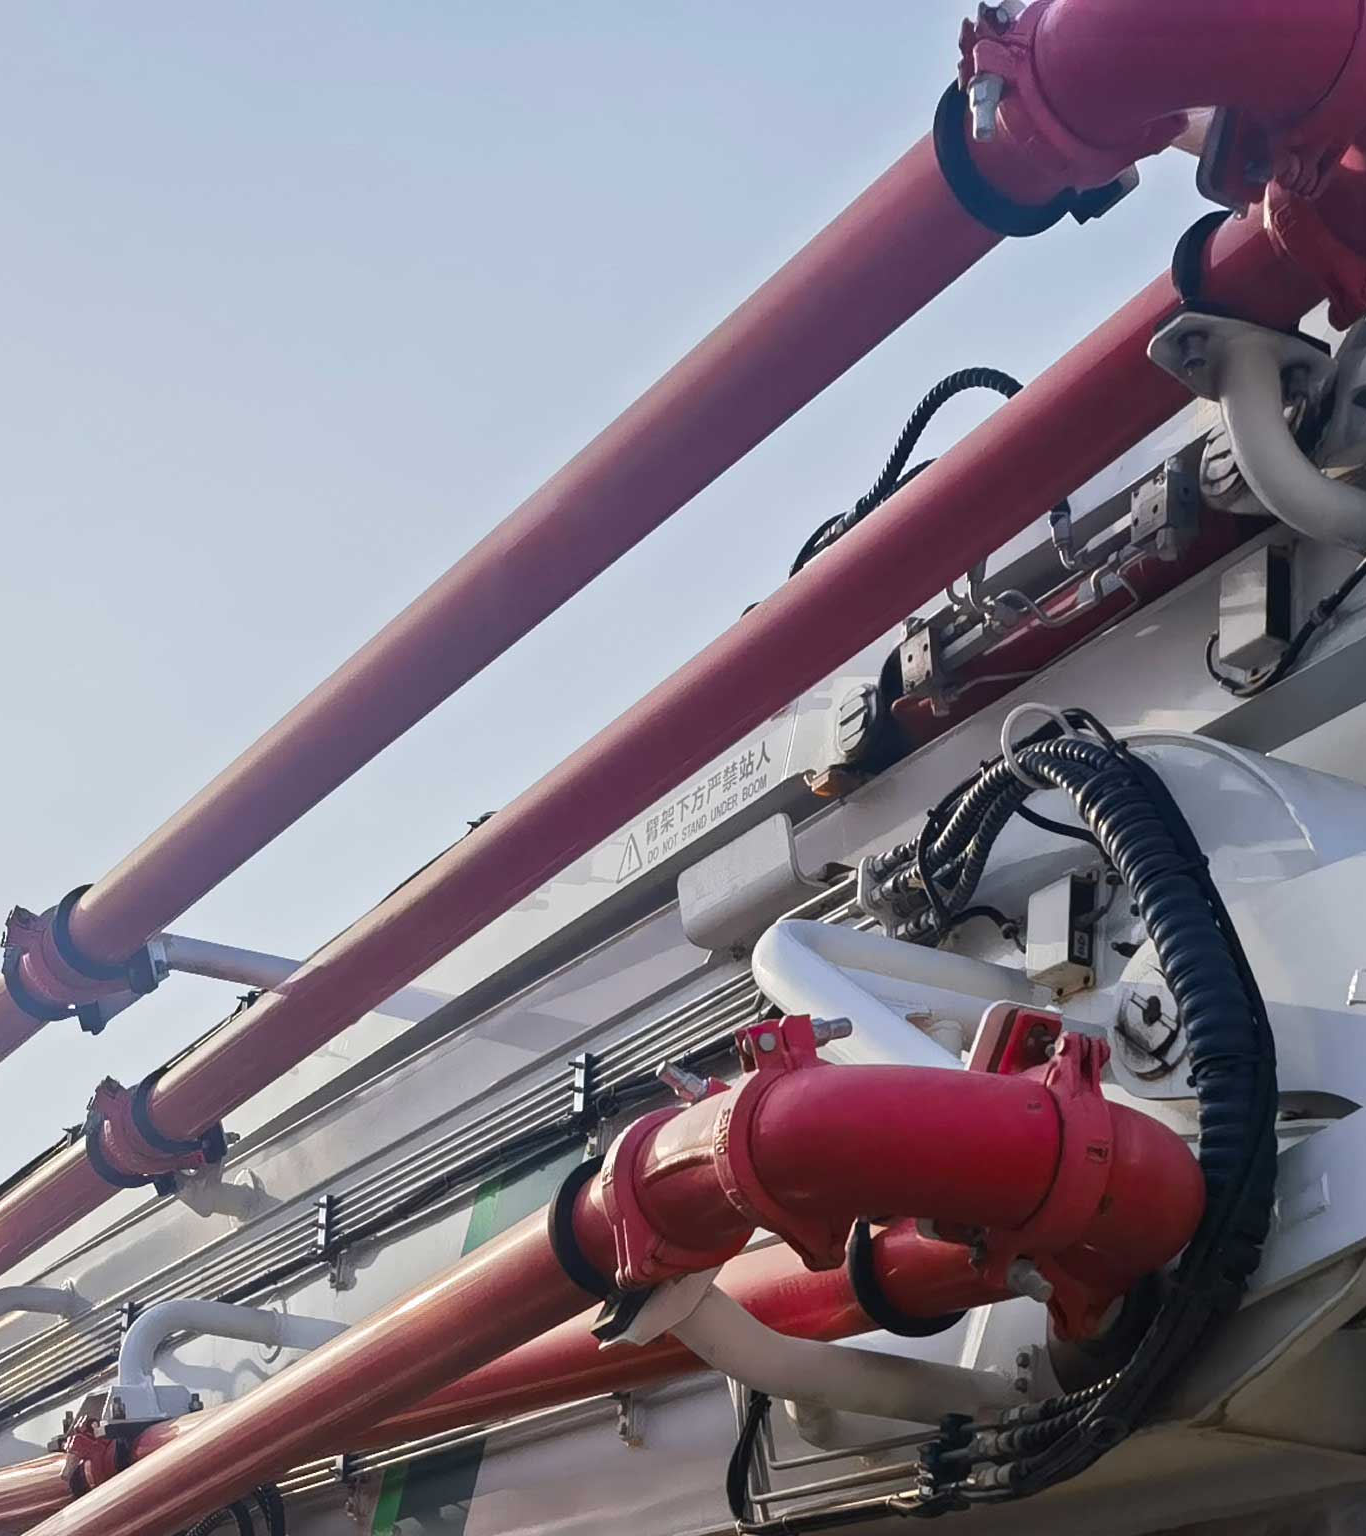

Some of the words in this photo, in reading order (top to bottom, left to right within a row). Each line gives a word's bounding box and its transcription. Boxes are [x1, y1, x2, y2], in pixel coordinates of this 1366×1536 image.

[646, 740, 771, 845] 臂架下方严禁站人
[647, 846, 659, 864] DO
[662, 831, 678, 854] NOT
[681, 813, 707, 841] STAND
[710, 792, 738, 822] UNDER
[742, 772, 767, 802] BOOM
